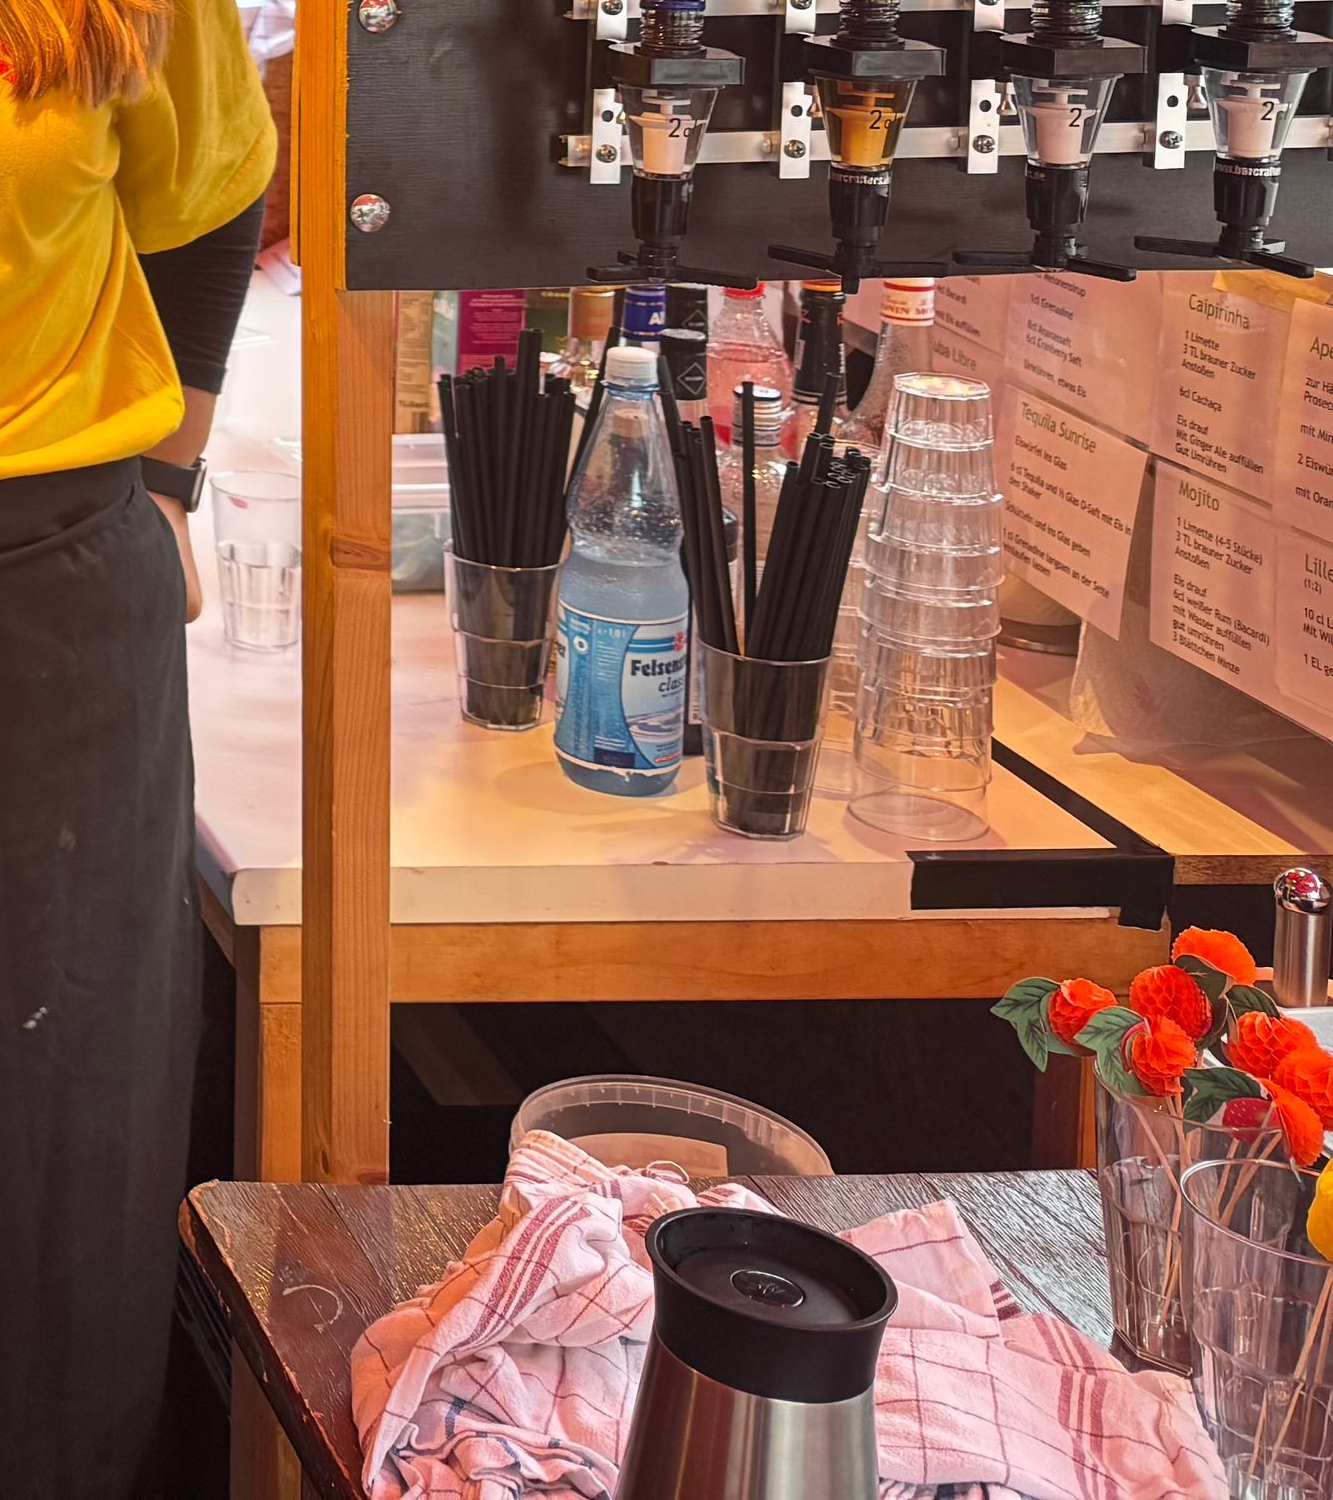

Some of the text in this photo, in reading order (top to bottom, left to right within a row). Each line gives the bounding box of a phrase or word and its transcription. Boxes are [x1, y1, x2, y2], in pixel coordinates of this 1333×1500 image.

[1189, 294, 1251, 330] Caipirinha
[1190, 332, 1220, 351] Limette
[1181, 358, 1215, 379] Anstoßen
[1189, 345, 1200, 358] TL
[1199, 350, 1229, 369] brauner
[1229, 361, 1257, 380] Zucker
[1305, 376, 1321, 389] zur
[1191, 390, 1222, 413] Cachaça
[1021, 401, 1097, 454] Tequila Sunrise
[1176, 414, 1209, 436] Eis drauf
[1300, 422, 1317, 439] mit
[1175, 442, 1228, 473] Gut Umrühren
[1176, 428, 1265, 475] Mit Ginger Ale auffüllen
[1178, 479, 1220, 512] Mojito
[1295, 486, 1312, 500] mit
[1181, 532, 1193, 548] TL
[1193, 538, 1225, 562] brauner
[1225, 553, 1254, 575] Zucker
[1182, 518, 1215, 542] Limette
[1232, 539, 1263, 567] Stücke)
[1174, 546, 1211, 570] Anstoßen
[1173, 573, 1209, 598] Eis drauf
[1303, 578, 1322, 595] (1:2)
[1304, 607, 1325, 624] 10 cl
[1187, 610, 1215, 632] Wasser
[1214, 624, 1252, 652] auffüllen
[1187, 626, 1225, 652] umrühren
[1213, 608, 1233, 626] Rum
[1232, 618, 1271, 648] (Bacardi)
[1302, 623, 1318, 638] Mit
[1216, 655, 1241, 676] Minze
[1311, 656, 1323, 671] EL
